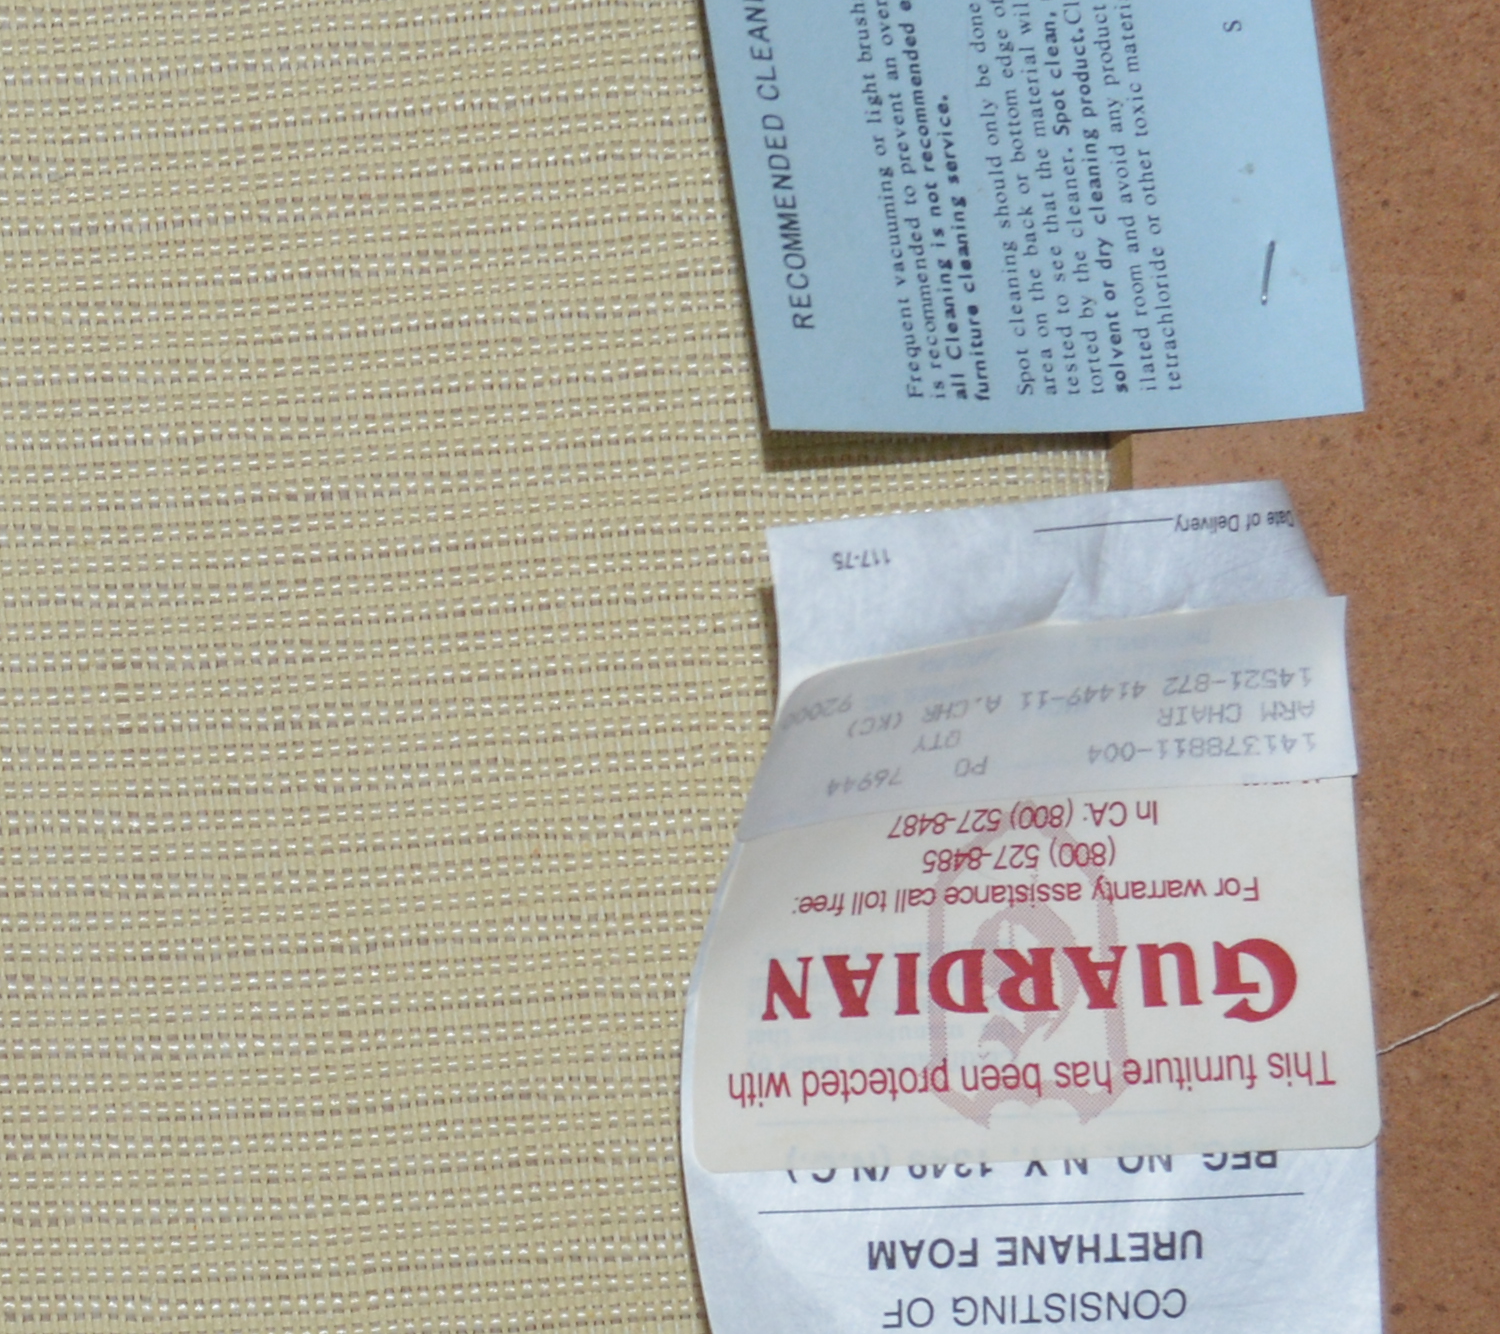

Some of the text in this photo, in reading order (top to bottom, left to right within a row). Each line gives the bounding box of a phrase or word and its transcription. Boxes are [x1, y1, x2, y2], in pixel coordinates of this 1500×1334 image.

[1221, 18, 1243, 33] S
[884, 55, 900, 81] an
[860, 72, 884, 124] light
[897, 21, 936, 173] recommended
[871, 134, 887, 157] or
[887, 91, 917, 175] prevent
[902, 183, 918, 205] to
[923, 181, 942, 217] not
[760, 112, 815, 330] RECOMMENDED
[877, 165, 906, 287] vacuuming
[929, 226, 946, 248] is
[936, 94, 991, 401] furniture cleaning service.
[902, 215, 942, 369] recommended
[936, 257, 963, 361] Cleaning
[896, 297, 924, 399] Frequent
[932, 379, 946, 399] is
[948, 372, 968, 400] all
[1170, 509, 1294, 534] Date of Delivery
[830, 548, 891, 572] 117-75
[1020, 679, 1147, 711] 41449-11
[1161, 665, 1312, 697] 14521-872
[1155, 701, 1243, 728] CHAIR
[1259, 698, 1316, 722] ARM
[825, 766, 902, 797] 76944
[953, 754, 989, 778] PO
[886, 798, 1158, 839] In CA: (800) 527-8487
[921, 834, 1116, 874] (800) 527-8485
[788, 876, 1260, 919] For warranty assistance call toll free:
[760, 936, 1298, 1023] GUARDIAN
[727, 1050, 1337, 1108] This furniture has been protected with
[866, 1228, 1203, 1271] URETHANE FOAM
[881, 1286, 1187, 1329] CONSISTING OF
